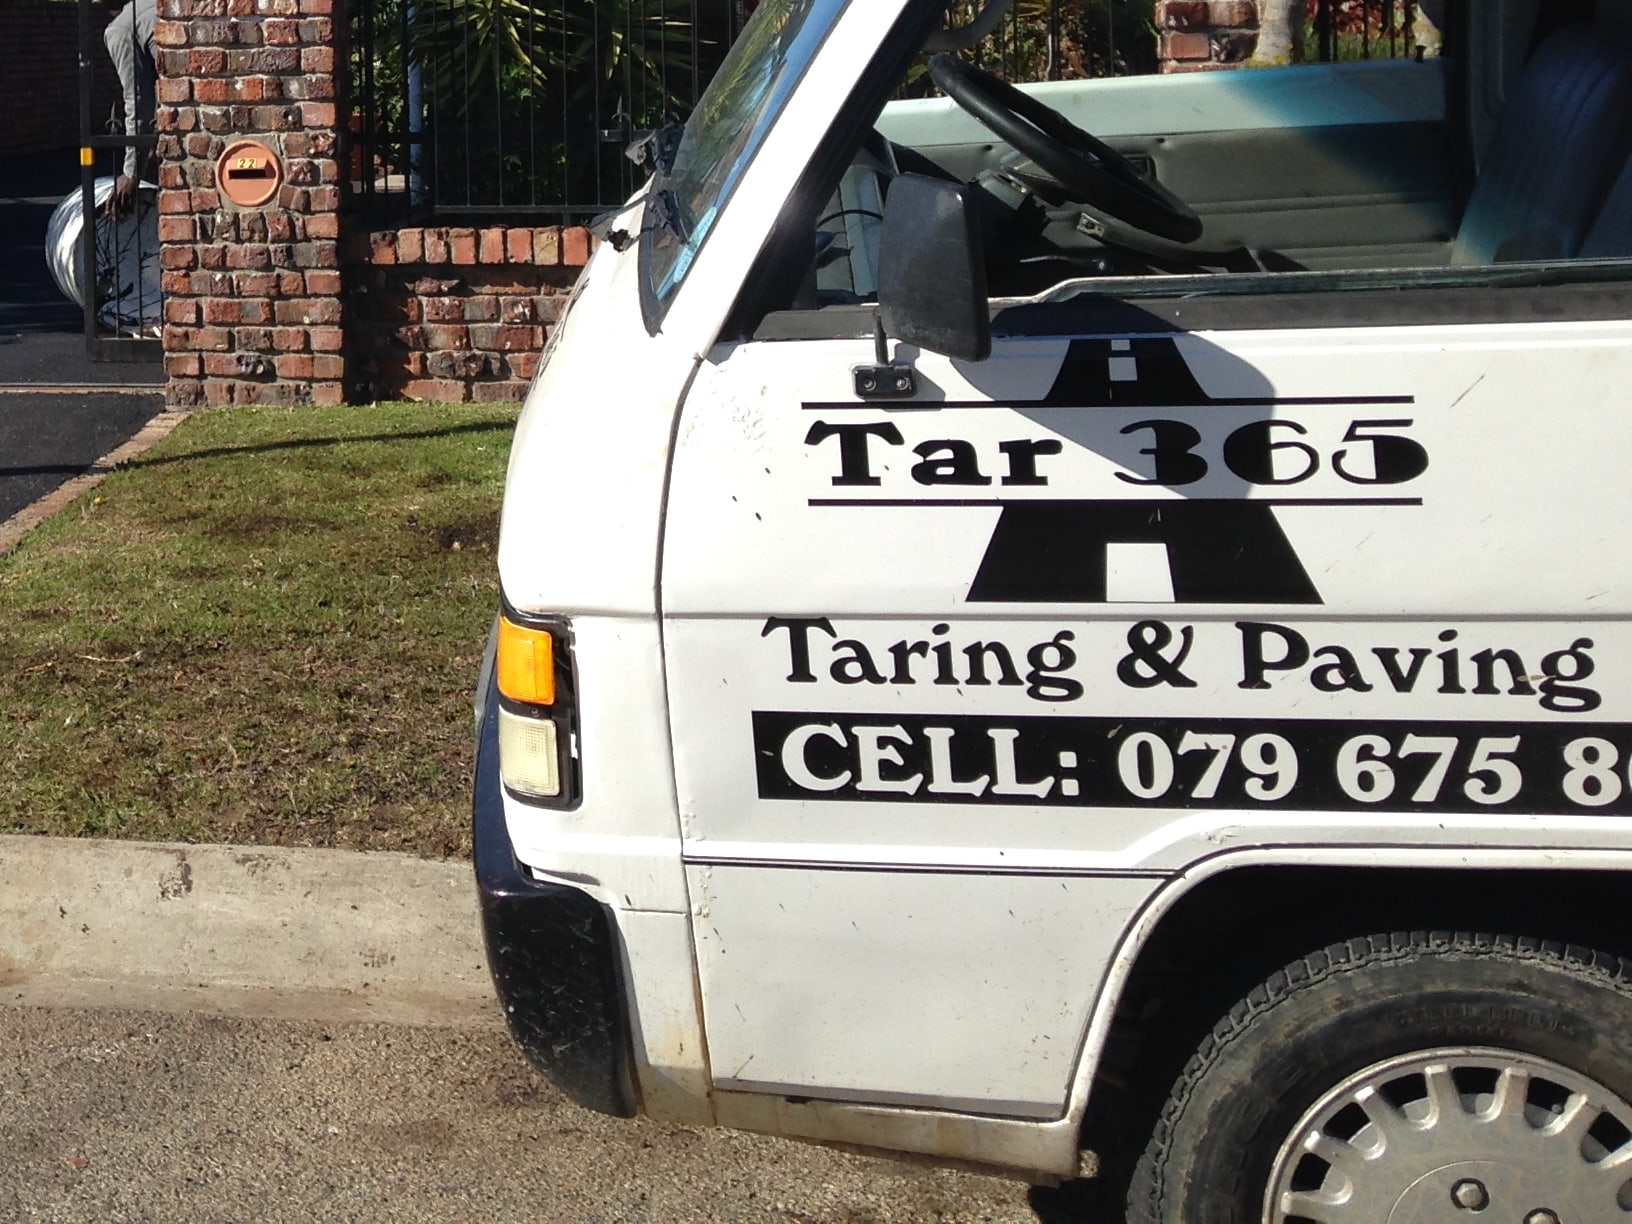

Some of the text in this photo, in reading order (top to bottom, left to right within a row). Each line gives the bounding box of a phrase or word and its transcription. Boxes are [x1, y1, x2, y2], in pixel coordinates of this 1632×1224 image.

[239, 158, 256, 168] 22
[805, 420, 1427, 485] Tar 365
[762, 617, 1601, 712] Taring & Paving
[781, 724, 1632, 806] CELL: 079 675 8
